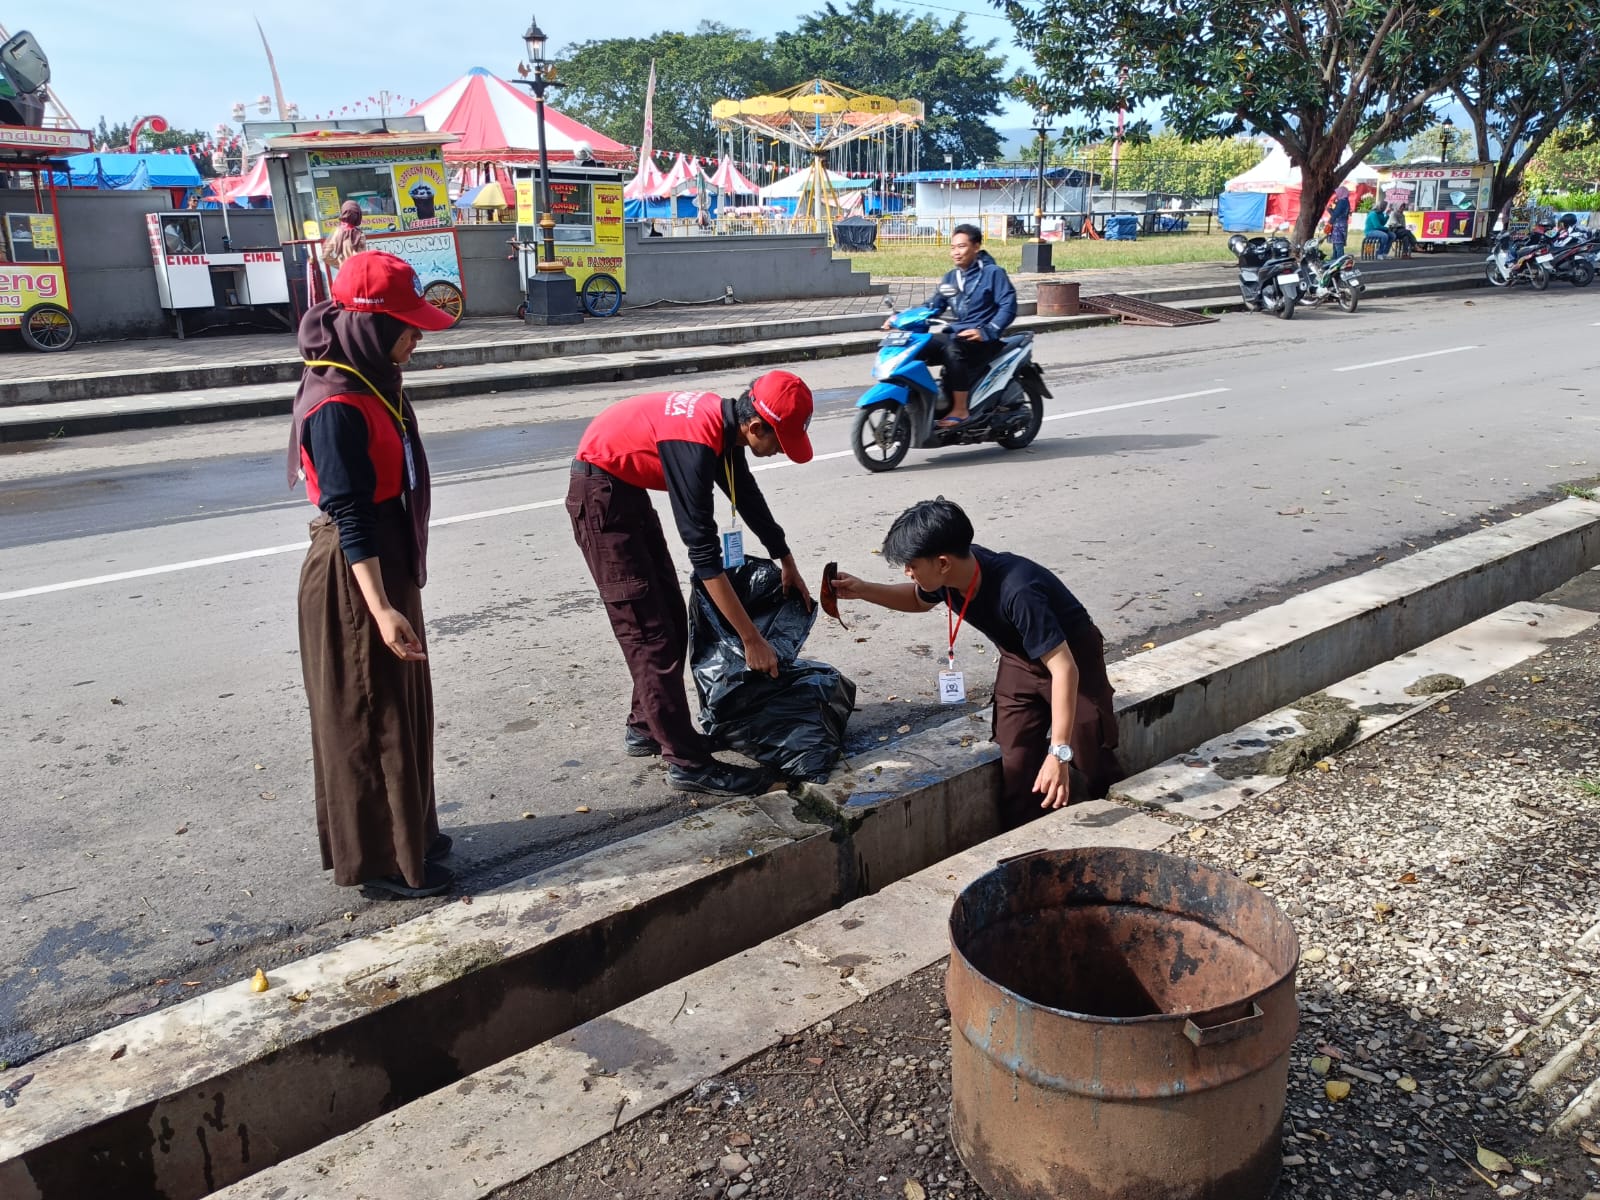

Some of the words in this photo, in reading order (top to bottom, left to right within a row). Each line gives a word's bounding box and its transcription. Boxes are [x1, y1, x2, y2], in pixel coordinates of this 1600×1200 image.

[1450, 169, 1471, 177] ES
[166, 255, 210, 266] CIMOL
[243, 252, 281, 262] CIMOL
[0, 273, 58, 297] eng
